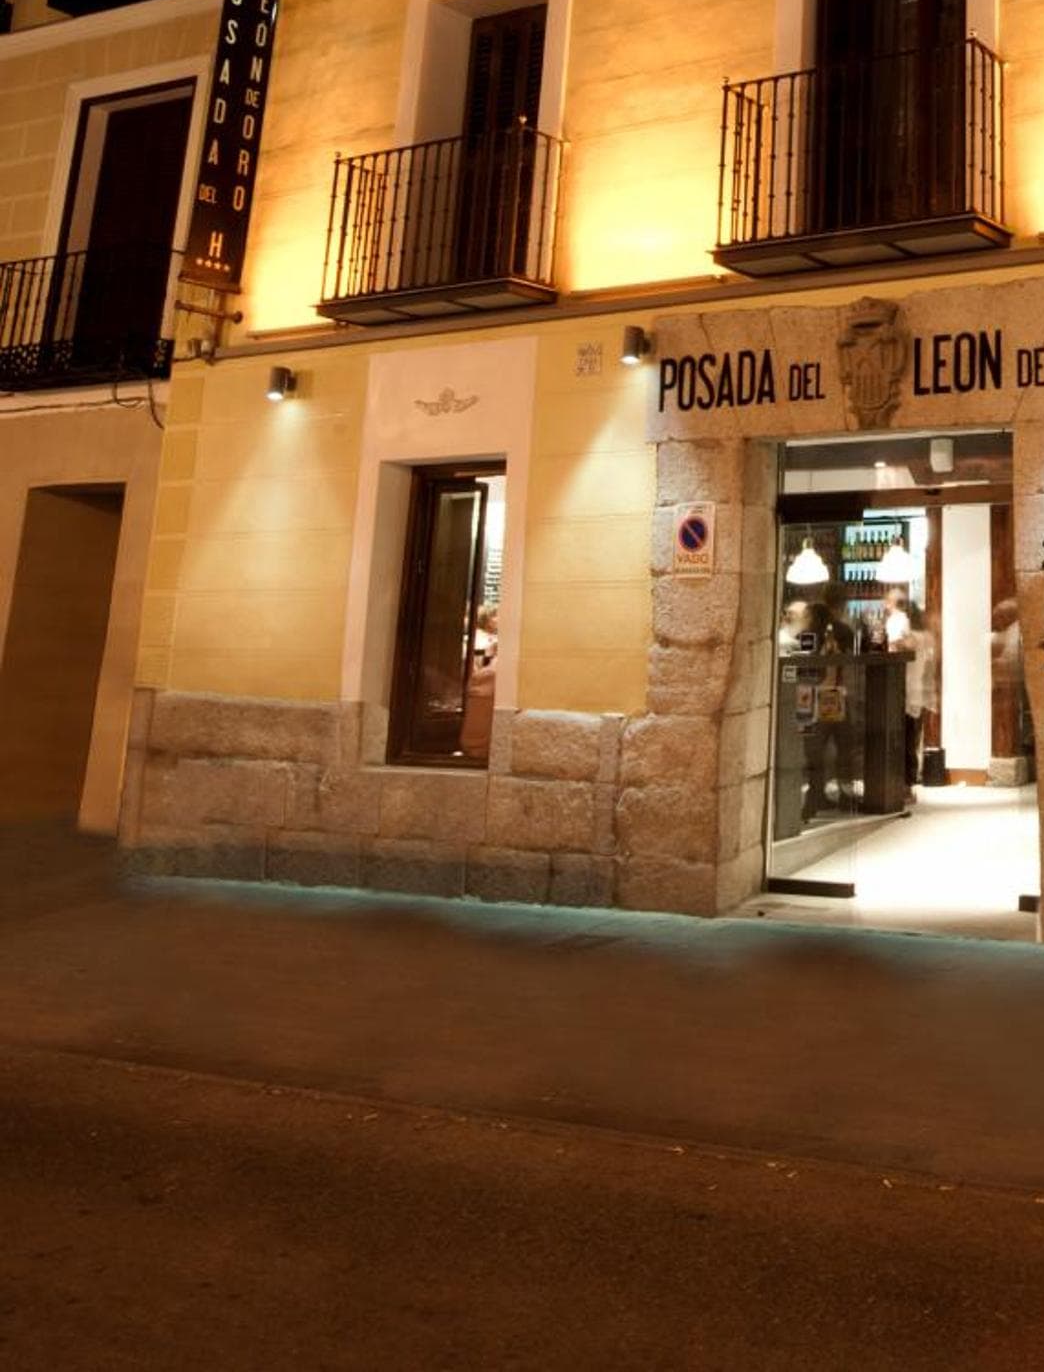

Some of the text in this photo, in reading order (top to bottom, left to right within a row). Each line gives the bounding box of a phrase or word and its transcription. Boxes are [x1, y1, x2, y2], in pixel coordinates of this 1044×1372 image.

[244, 88, 261, 108] DE
[232, 114, 255, 212] ORO
[198, 183, 217, 204] DEL
[208, 230, 224, 259] H
[658, 349, 776, 413] POSADA
[788, 362, 826, 402] DEL
[913, 329, 1003, 397] LEON
